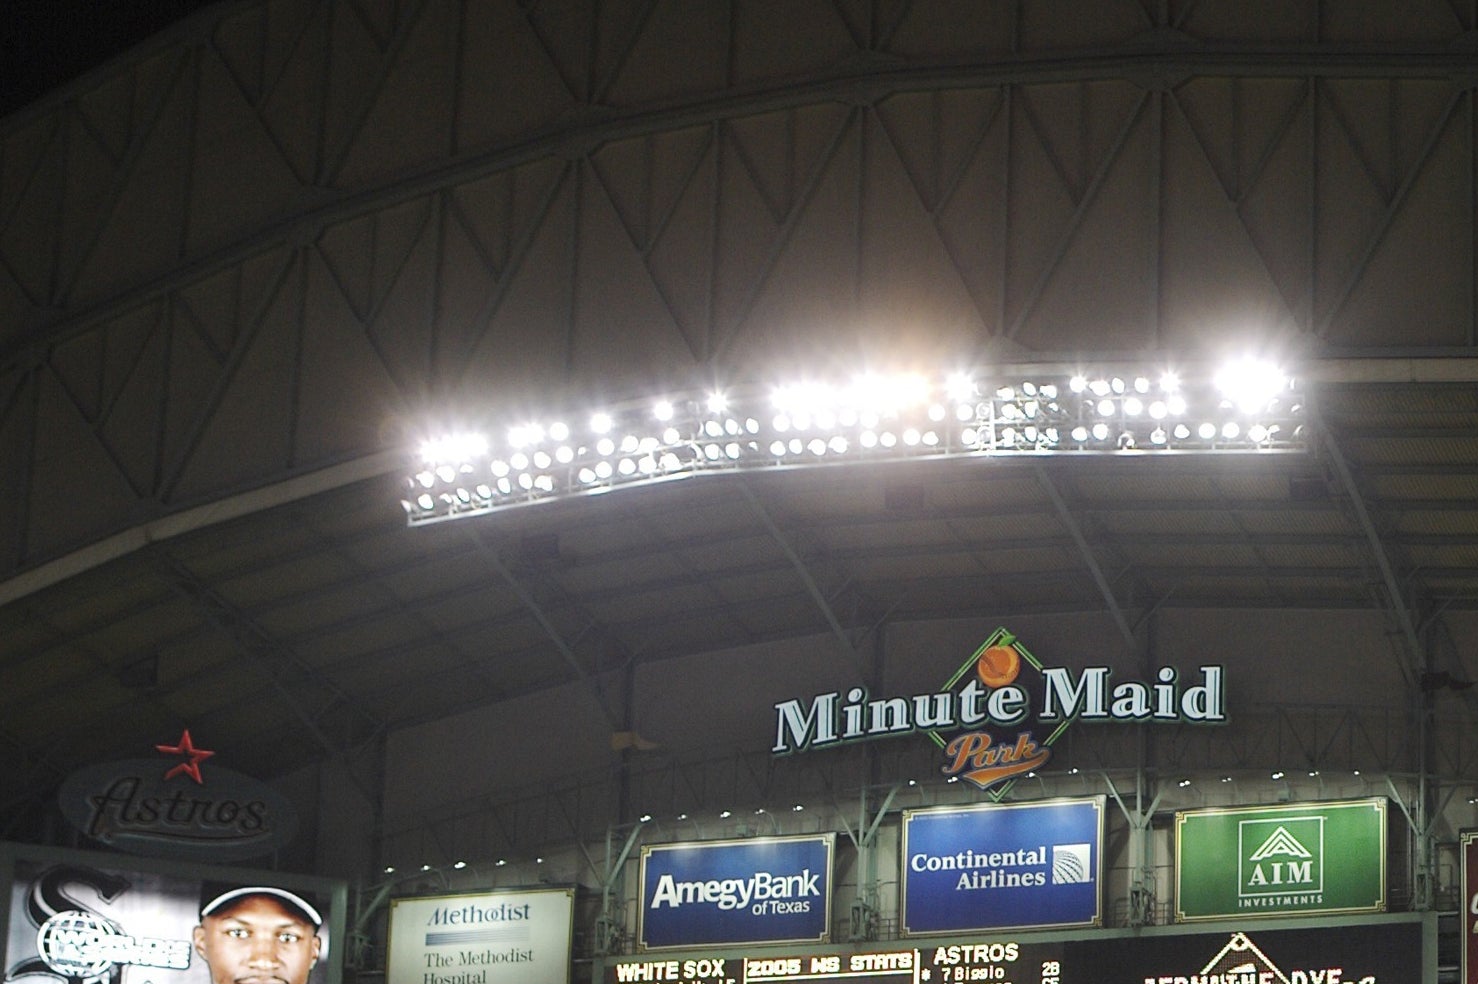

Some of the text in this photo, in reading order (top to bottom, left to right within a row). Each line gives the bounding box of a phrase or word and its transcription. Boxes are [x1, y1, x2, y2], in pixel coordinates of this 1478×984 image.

[772, 666, 1225, 753] Minute Maid
[943, 732, 1043, 774] Park
[88, 777, 269, 838] Astros
[911, 846, 1047, 872] Continental
[956, 869, 1046, 890] Airlines
[1248, 861, 1313, 886] AIM
[651, 869, 820, 910] AmegyBank
[1238, 894, 1323, 907] INVESTMENTS
[427, 903, 531, 926] Methodist
[752, 900, 810, 915] of Texas
[424, 948, 535, 967] The Methodist
[747, 953, 913, 977] 2005 WS STATS
[933, 943, 1019, 965] ASTROS
[616, 959, 725, 982] WHITE SOX
[941, 961, 1060, 981] 7 Biggio 2B
